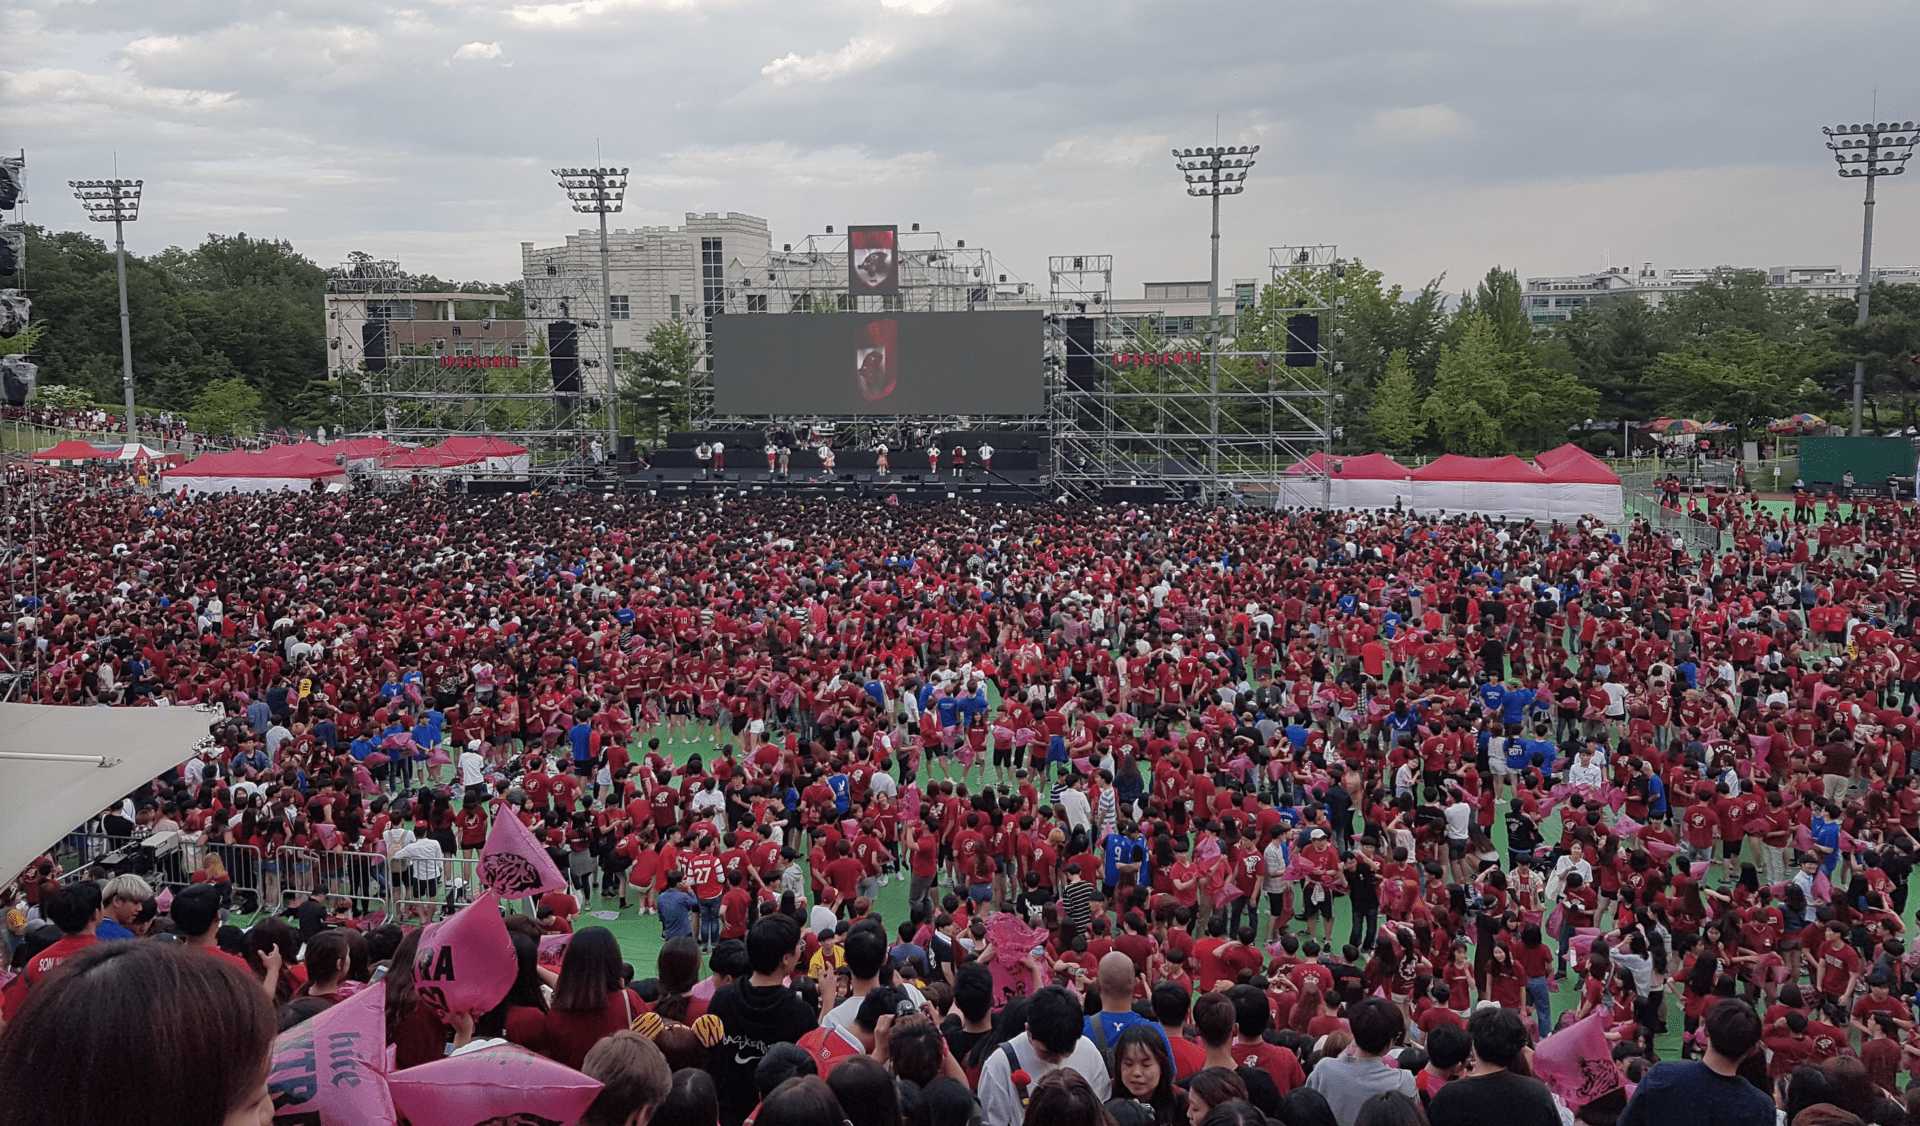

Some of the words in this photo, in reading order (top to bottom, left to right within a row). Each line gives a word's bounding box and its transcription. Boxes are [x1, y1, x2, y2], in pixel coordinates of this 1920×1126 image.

[440, 355, 518, 368] IPSELENTI
[1113, 352, 1201, 366] IPSELENTI
[694, 867, 711, 884] 27
